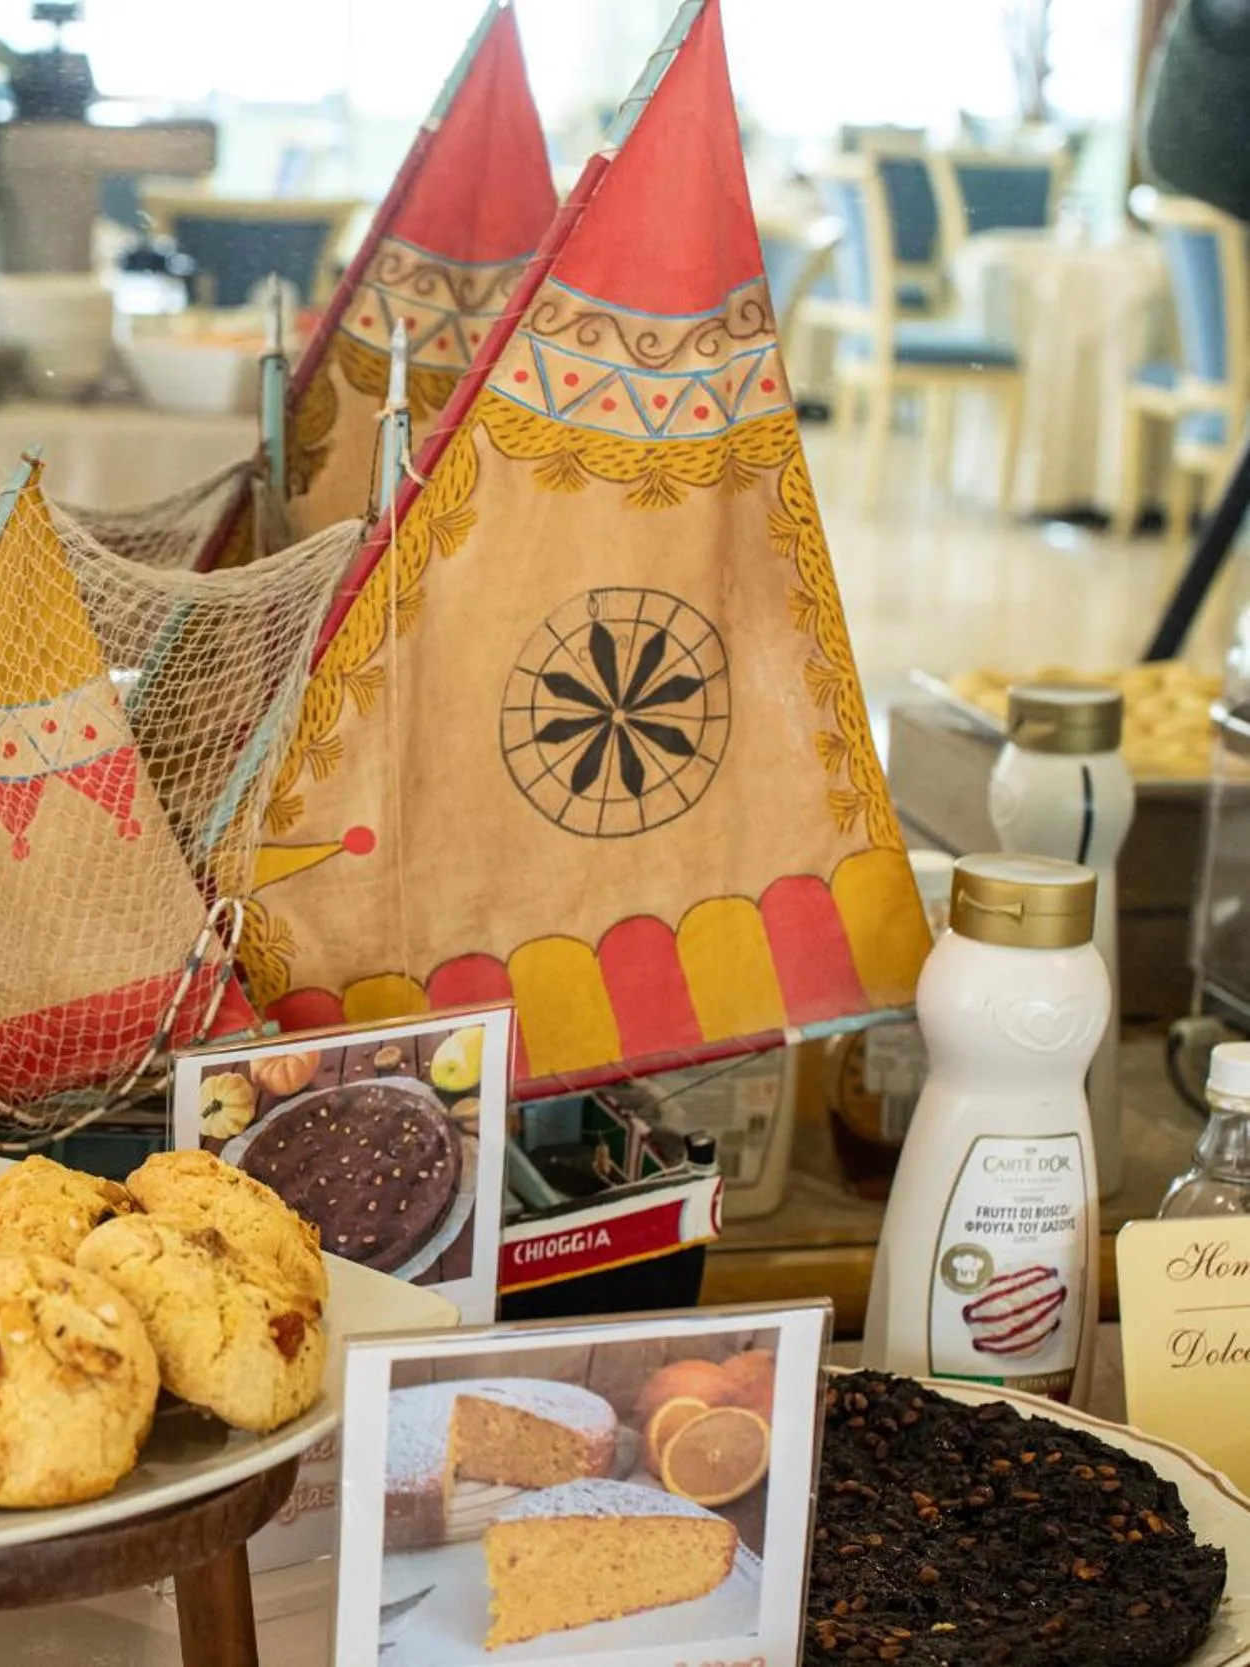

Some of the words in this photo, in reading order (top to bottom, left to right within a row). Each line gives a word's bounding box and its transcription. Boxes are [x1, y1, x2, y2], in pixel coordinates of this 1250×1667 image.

[976, 1205, 1017, 1219] FRUTTI
[1019, 1206, 1033, 1219] DI
[514, 1228, 611, 1265] CHIOGGIA
